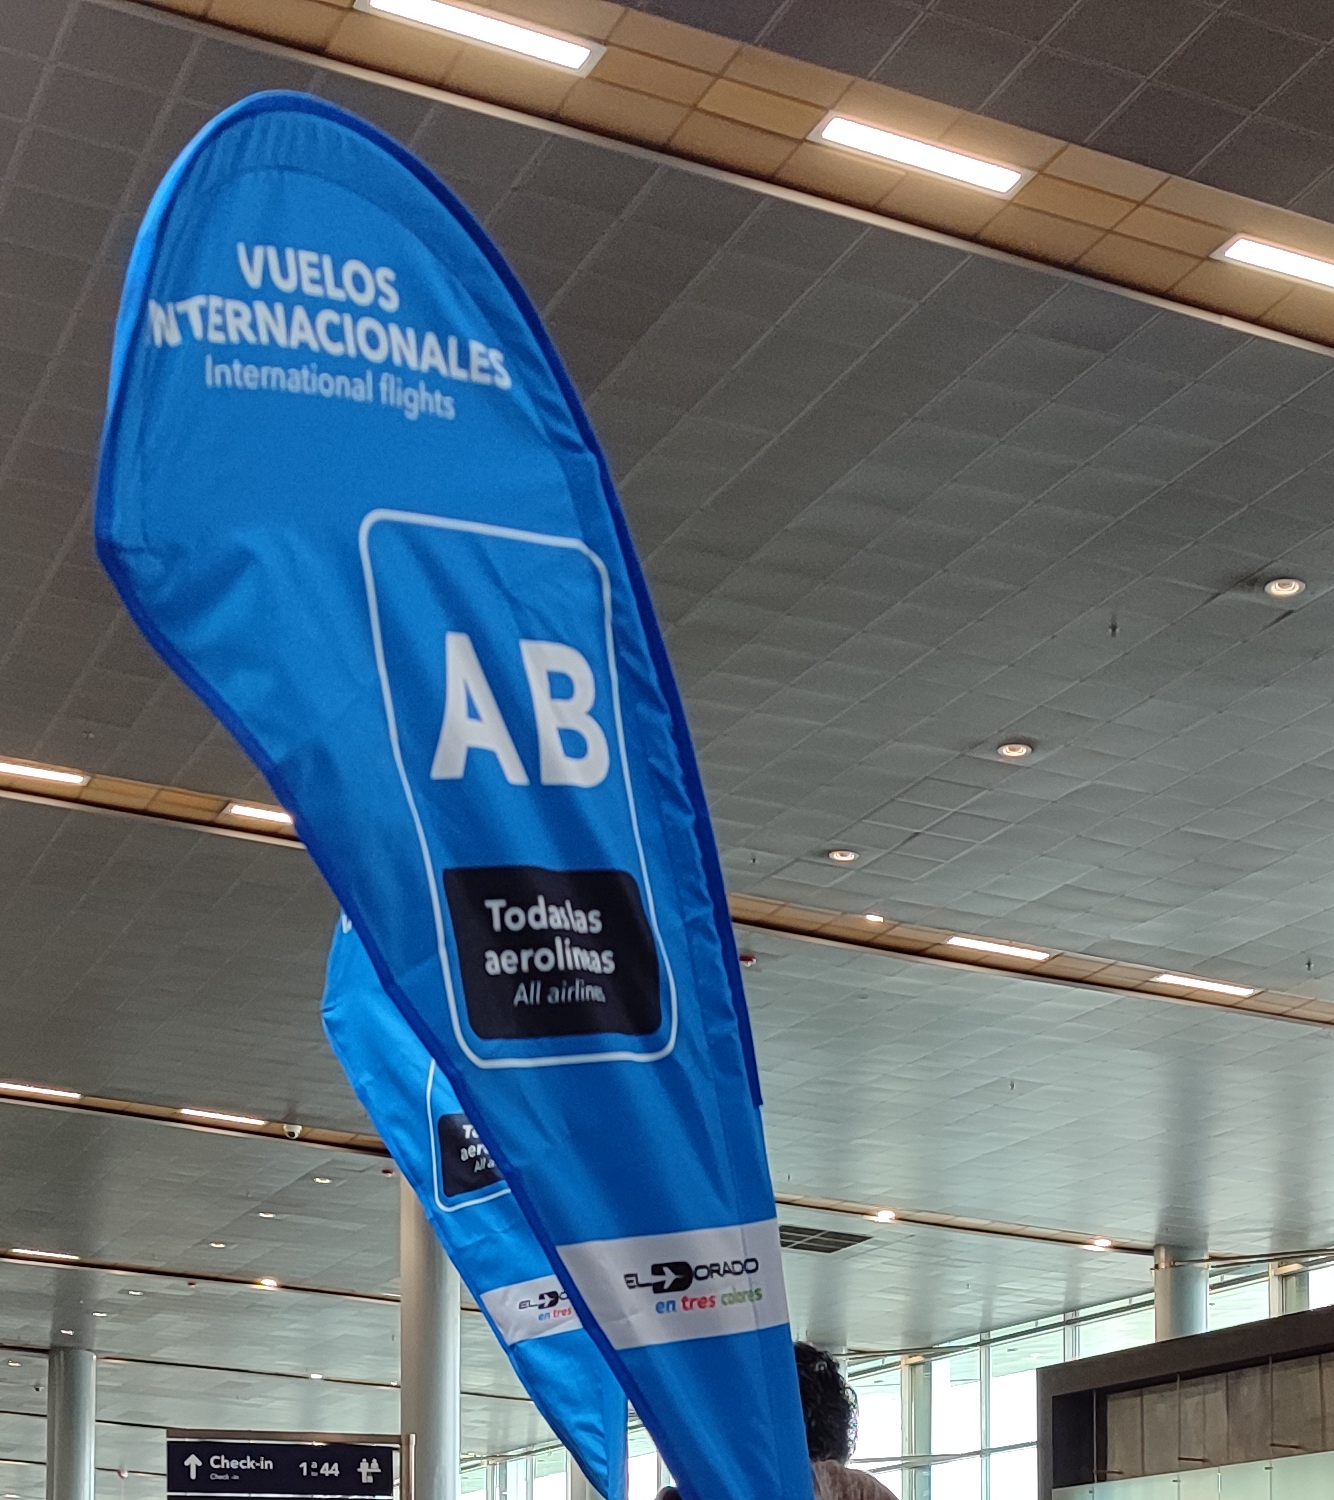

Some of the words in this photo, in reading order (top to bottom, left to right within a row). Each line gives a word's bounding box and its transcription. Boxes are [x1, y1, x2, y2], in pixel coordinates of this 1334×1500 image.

[236, 241, 400, 313] VUELOS
[148, 294, 513, 390] NTERNACIONALES
[204, 353, 374, 403] International
[378, 370, 457, 421] flights
[430, 630, 611, 788] AB
[513, 979, 542, 1007] All
[655, 1300, 677, 1315] en
[681, 1294, 717, 1312] tres
[720, 1284, 763, 1307] colores
[209, 1455, 274, 1471] Check-in
[319, 1462, 340, 1477] 44
